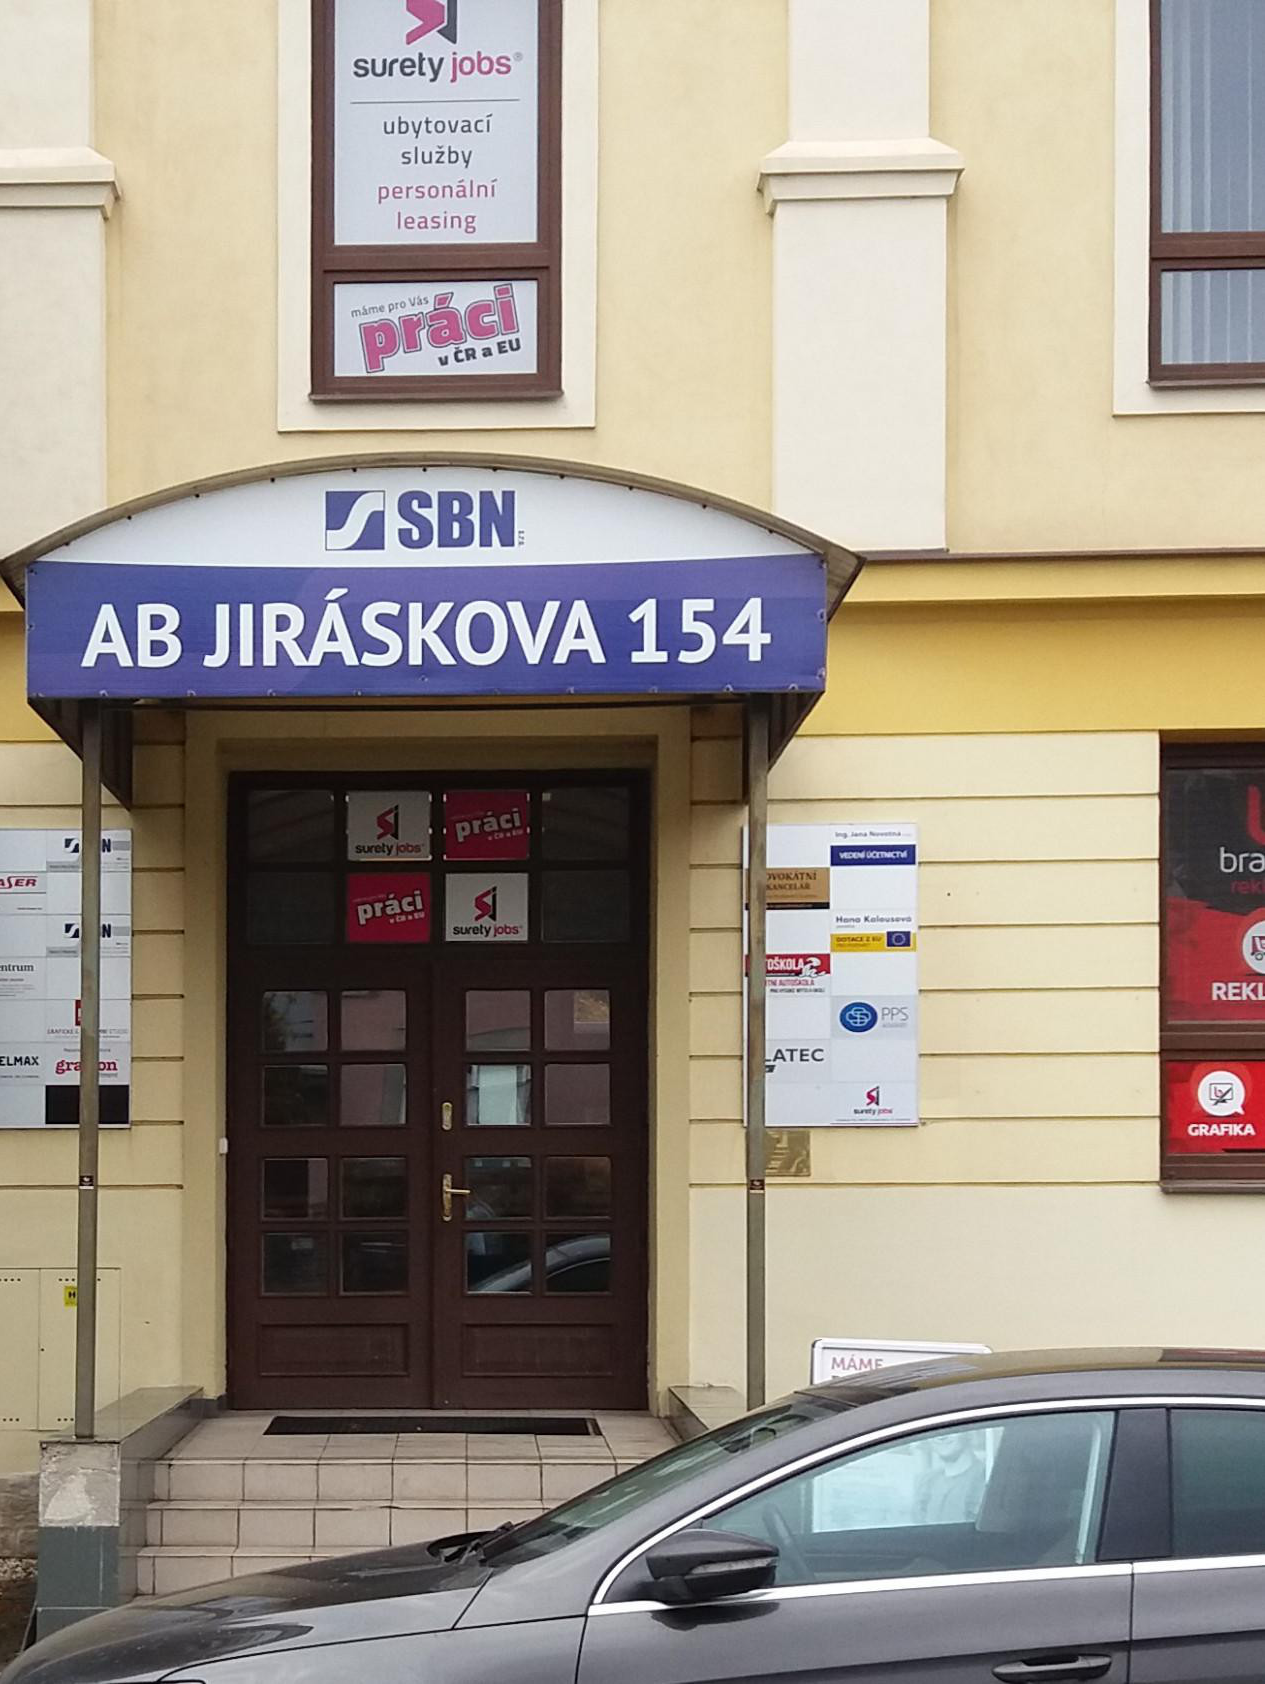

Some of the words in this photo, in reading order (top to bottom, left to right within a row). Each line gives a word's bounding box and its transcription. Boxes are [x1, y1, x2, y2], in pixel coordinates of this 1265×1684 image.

[352, 52, 444, 83] surety
[450, 51, 512, 83] jobs
[383, 113, 493, 139] ubytovací
[401, 145, 473, 168] služby
[378, 178, 498, 204] personální
[397, 211, 477, 234] leasing
[351, 303, 385, 318] máme
[388, 300, 407, 313] pro
[407, 295, 430, 307] Vás
[359, 283, 520, 373] práci
[438, 354, 449, 366] v
[453, 346, 477, 363] ČR
[481, 346, 493, 358] a
[496, 337, 521, 355] EU
[397, 489, 518, 551] SBN
[81, 603, 183, 669] AB
[203, 588, 606, 669] JIRÁSKOVA
[627, 597, 772, 664] 154
[455, 807, 522, 843] práci
[355, 842, 394, 856] surety
[357, 889, 424, 926] práci
[453, 924, 491, 938] surety
[493, 924, 519, 938] jobs
[881, 1006, 909, 1021] PPS
[55, 1059, 118, 1075] graon
[1187, 1123, 1256, 1136] GRAFIKA
